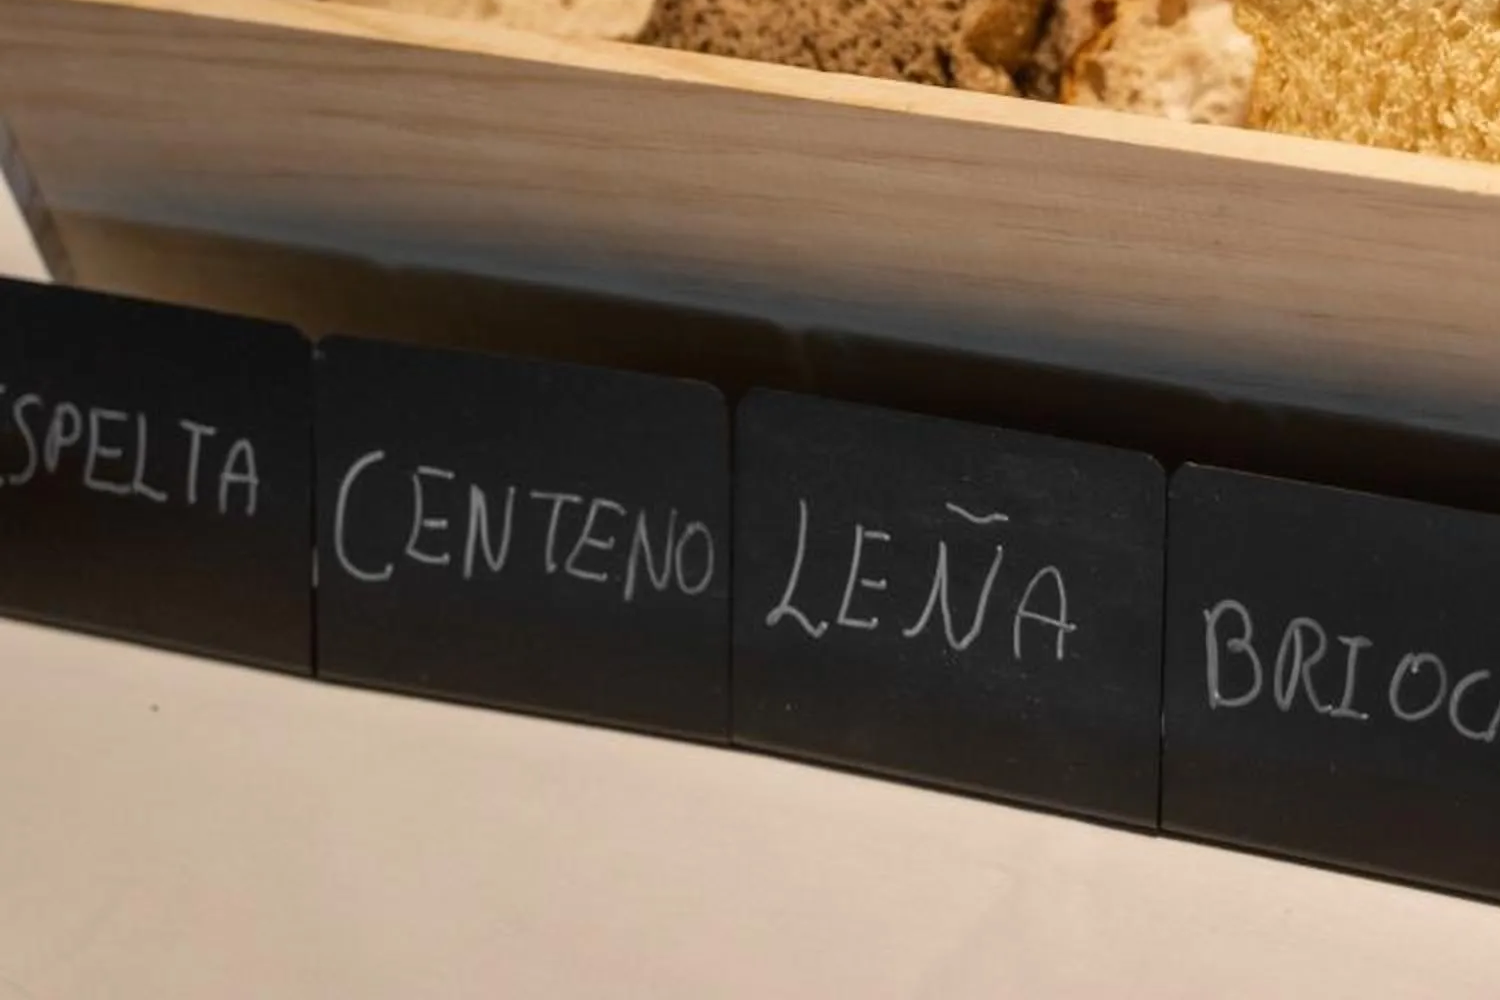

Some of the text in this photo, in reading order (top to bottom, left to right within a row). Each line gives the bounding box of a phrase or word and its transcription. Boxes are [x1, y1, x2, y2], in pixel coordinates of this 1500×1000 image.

[0, 384, 260, 517] SPELTA
[335, 449, 715, 601] CENTENO
[765, 498, 1078, 662] LEÑA
